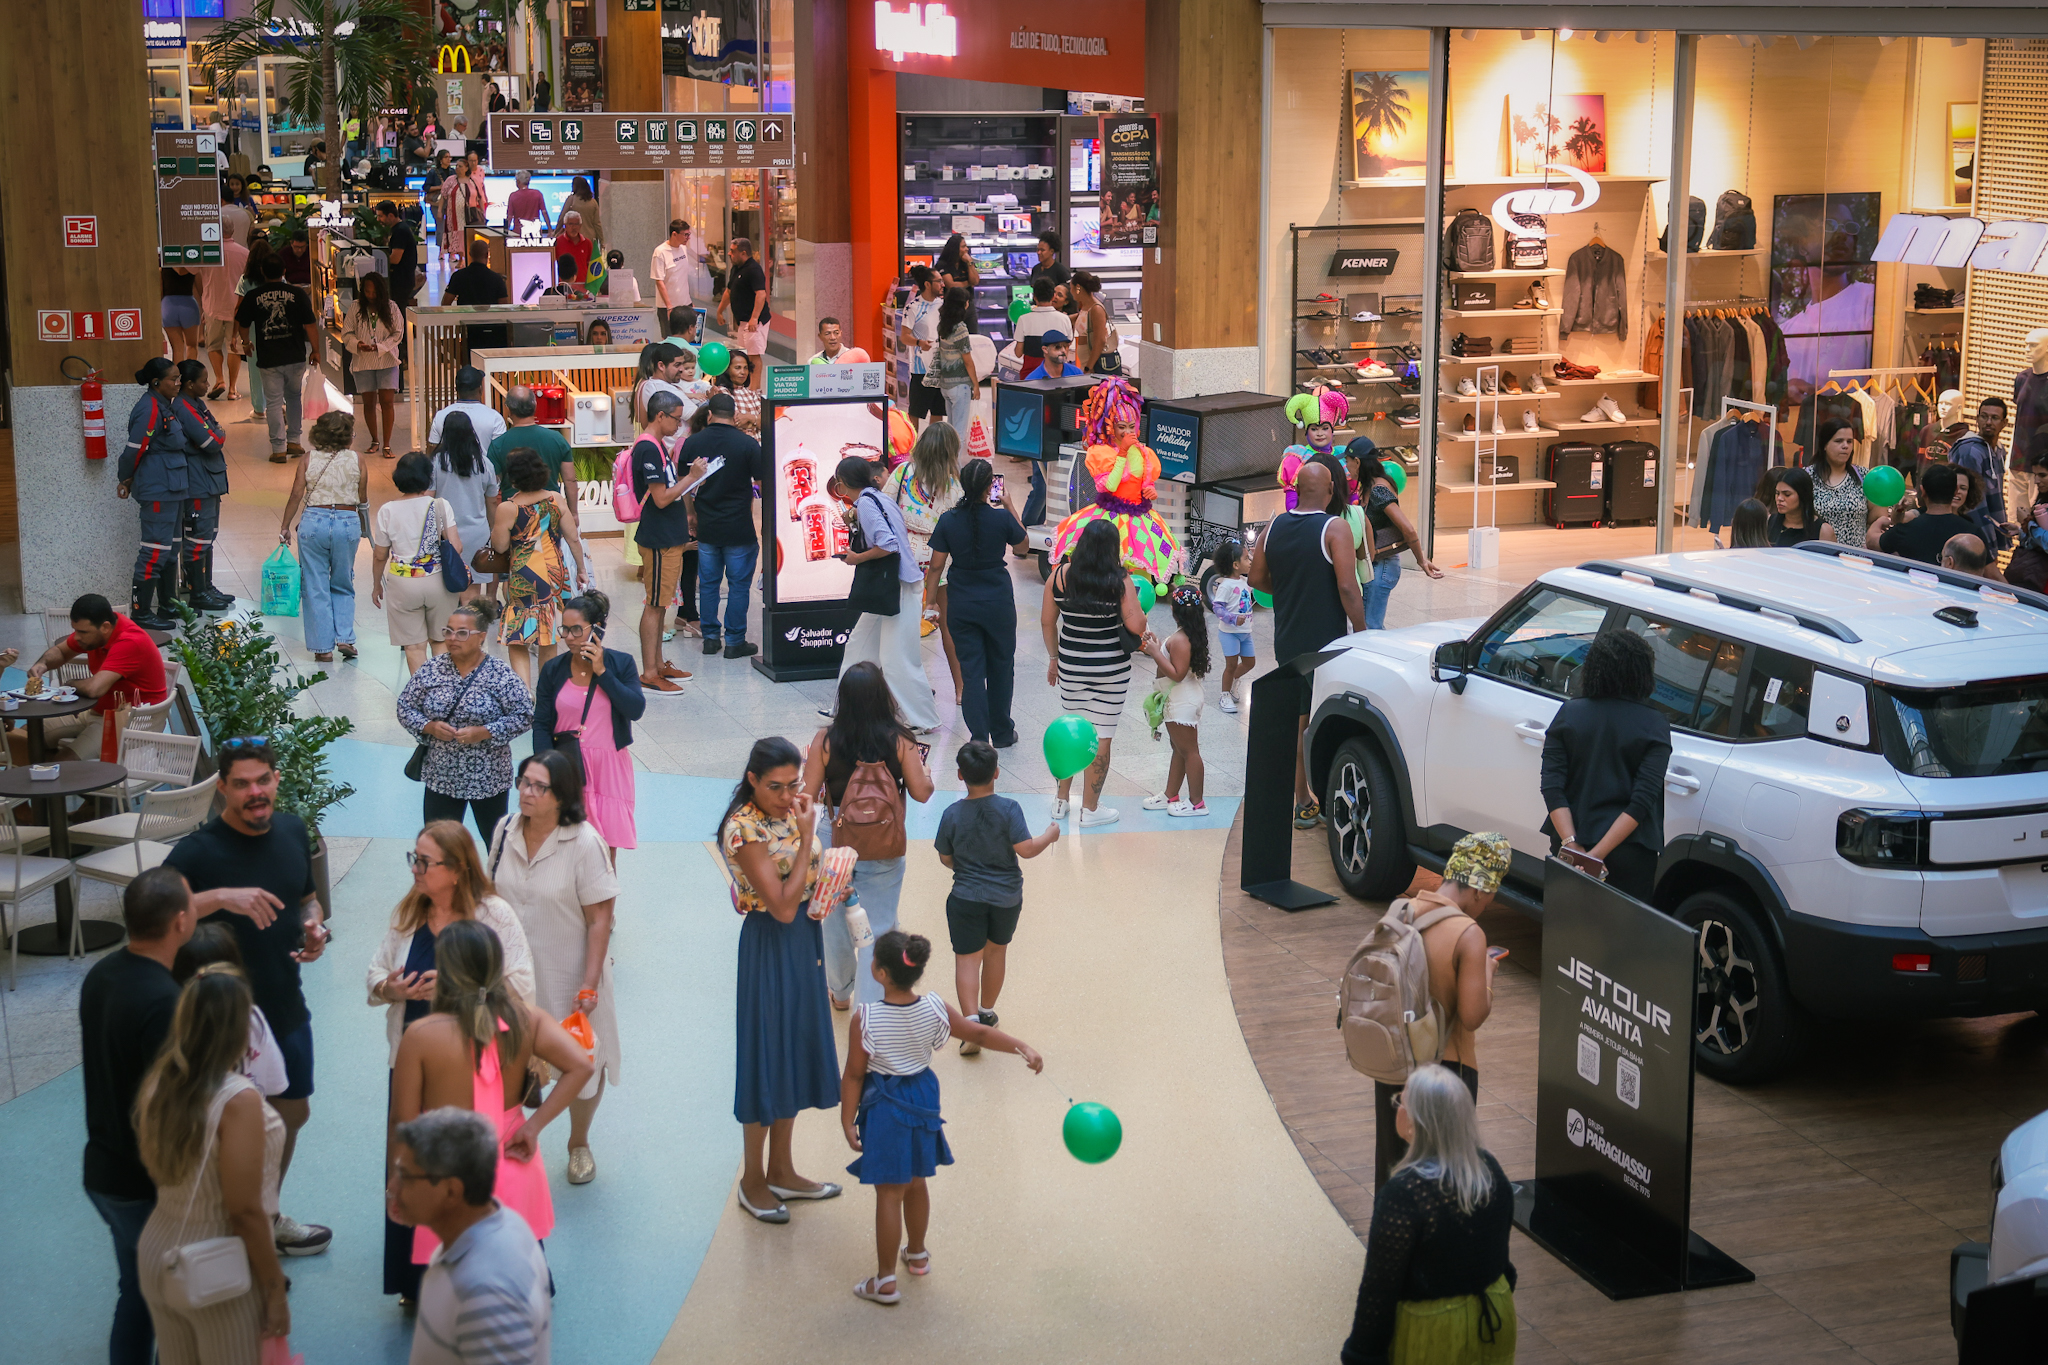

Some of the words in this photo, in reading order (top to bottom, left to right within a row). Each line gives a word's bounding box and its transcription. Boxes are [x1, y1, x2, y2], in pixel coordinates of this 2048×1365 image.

[1010, 25, 1030, 49] ALÉM
[1030, 32, 1040, 49] DE
[1040, 33, 1062, 55] TUDO,
[1062, 35, 1109, 56] TECNOLOGIA.
[1111, 129, 1150, 143] COPA
[307, 217, 355, 227] STANLEY
[506, 238, 556, 247] STANLEY
[1870, 213, 2048, 274] ma
[1341, 258, 1388, 269] KENNER
[256, 290, 295, 306] DISCIPLINE
[1464, 298, 1490, 306] mahalo
[1157, 424, 1191, 437] SALVADOR
[1156, 432, 1191, 451] Holiday
[1156, 448, 1167, 456] Viva
[1172, 451, 1189, 460] feriado
[808, 512, 826, 552] Bob's
[800, 628, 832, 638] Salvador
[800, 638, 833, 648] Shopping
[1558, 956, 1671, 1036] JETOUR
[1581, 996, 1642, 1048] AVANTA
[1580, 1022, 1584, 1030] A
[1584, 1024, 1604, 1042] PRIMEIRA
[1604, 1036, 1621, 1053] JETOUR
[1622, 1046, 1629, 1056] DA
[1630, 1051, 1644, 1066] BAHIA
[1588, 1118, 1604, 1134] GRUPO
[1586, 1128, 1651, 1184] PARAGUASSU
[1624, 1173, 1638, 1191] DESDE
[1639, 1185, 1650, 1198] 1975
